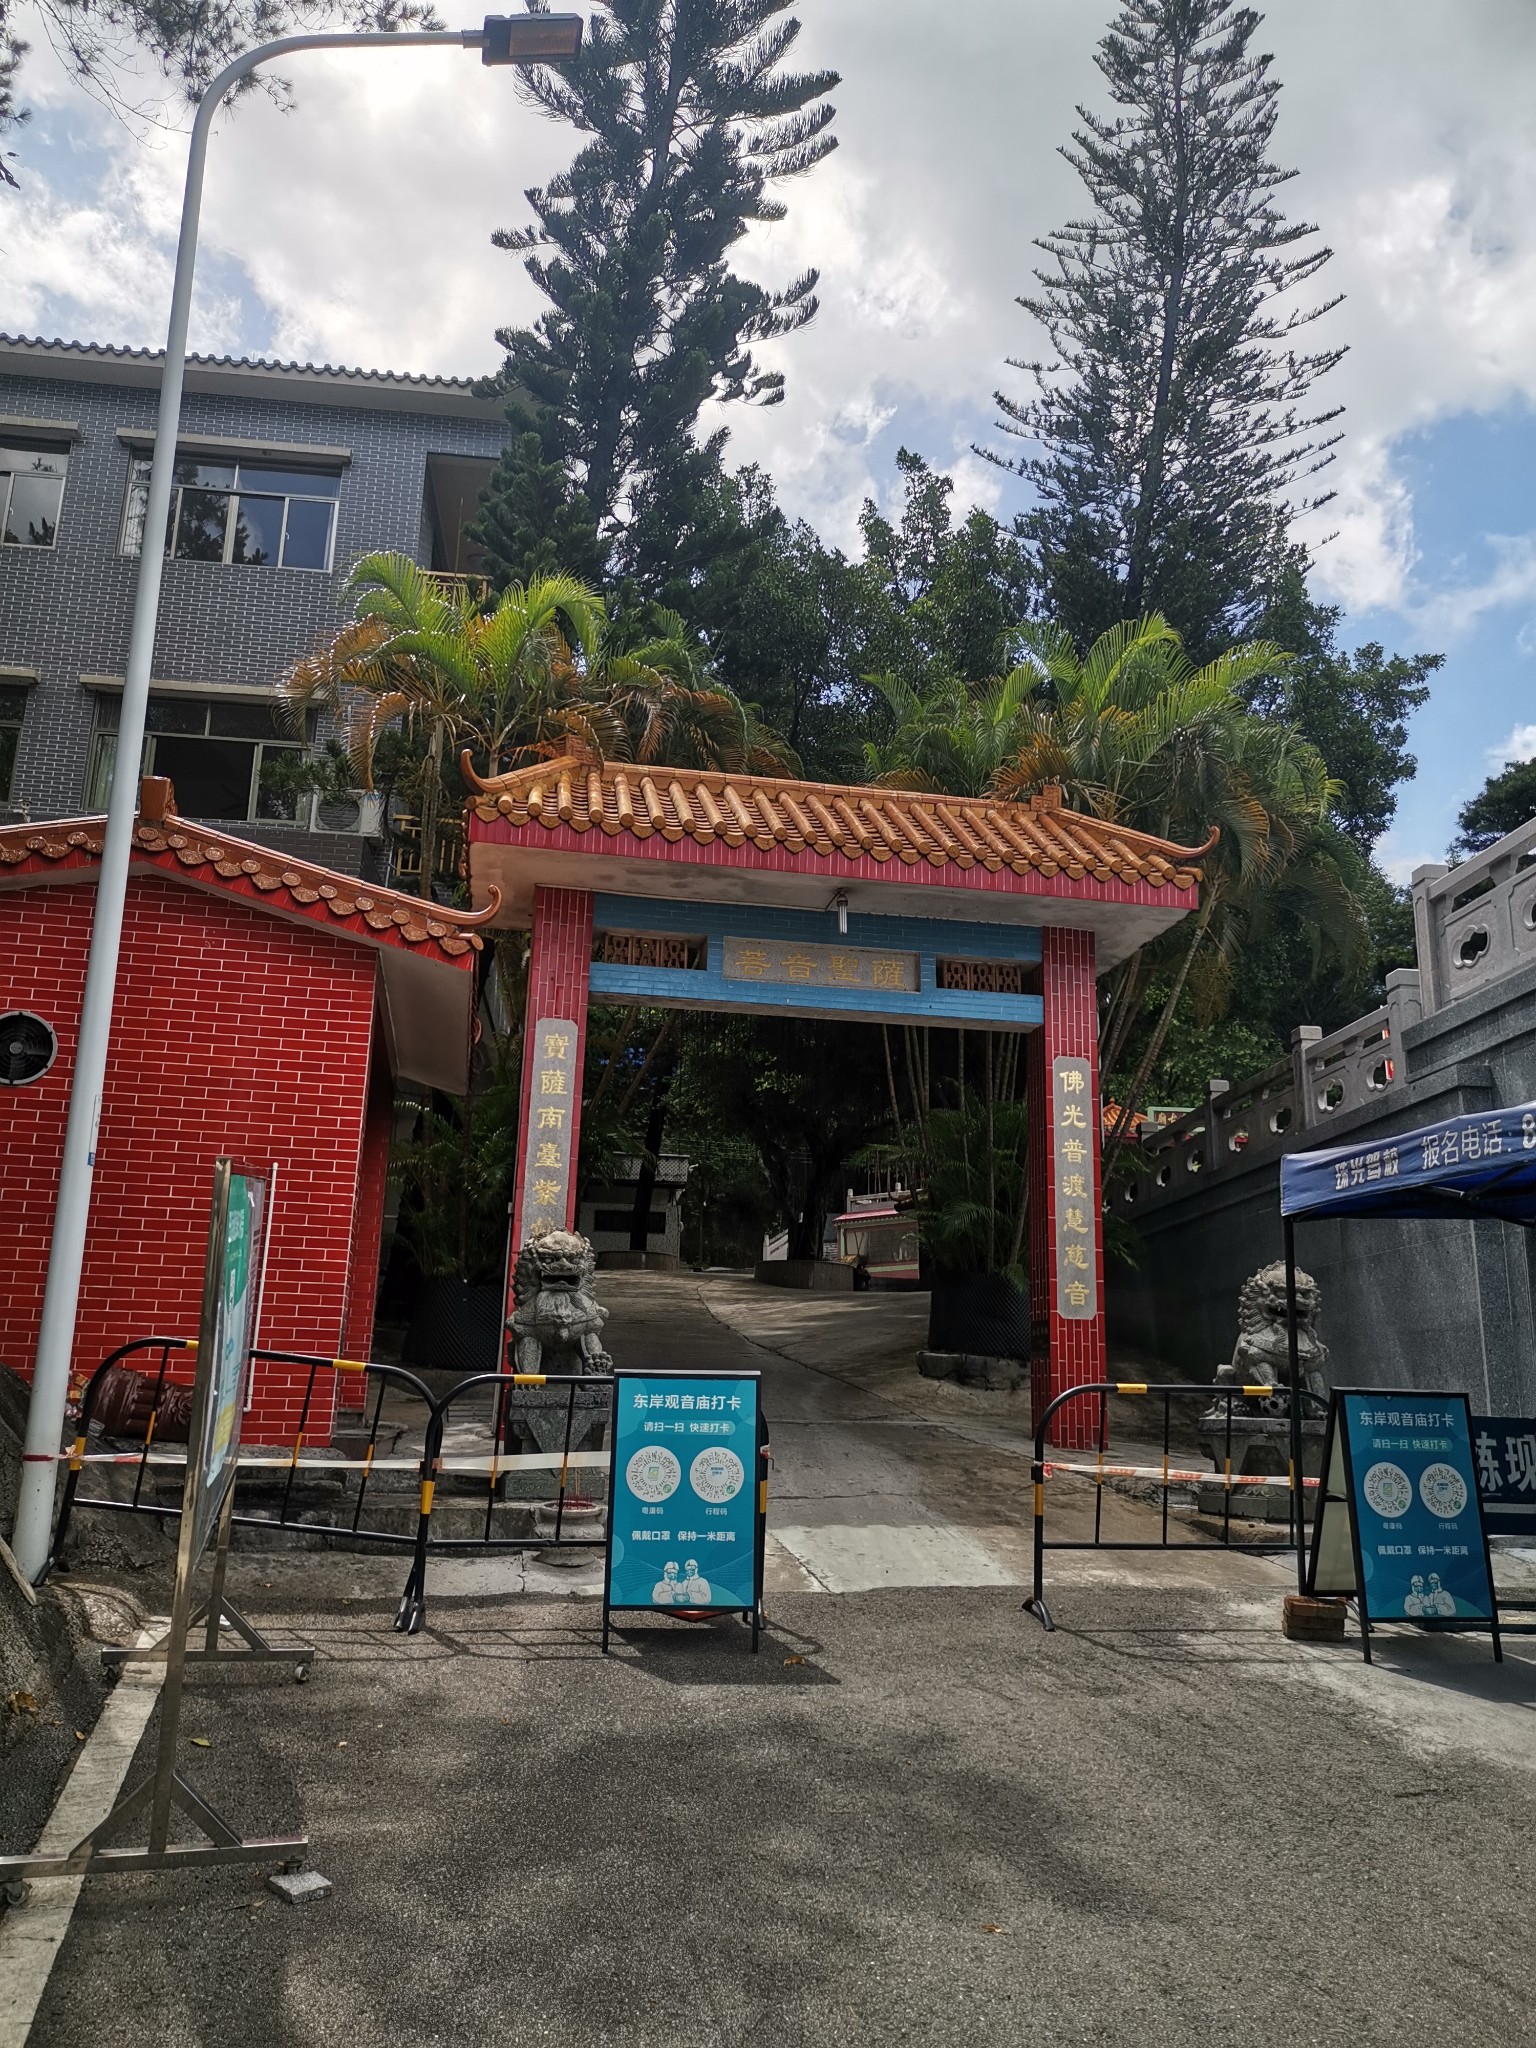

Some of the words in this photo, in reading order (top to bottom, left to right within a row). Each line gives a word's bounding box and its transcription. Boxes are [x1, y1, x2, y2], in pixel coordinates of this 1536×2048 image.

[633, 1393, 742, 1411] 东岸观音庙打卡
[1359, 1411, 1455, 1428] 东岸观音庙打卡
[643, 1421, 684, 1433] 请扫一扫
[689, 1422, 730, 1434] 快速打卡
[1372, 1438, 1408, 1449] 请扫一扫
[1412, 1439, 1448, 1450] 快速打卡
[705, 1507, 728, 1516] 行程码
[631, 1531, 671, 1541] 佩戴口罩
[677, 1531, 736, 1542] 保持一米距离
[1417, 1545, 1469, 1556] 保持一米距离
